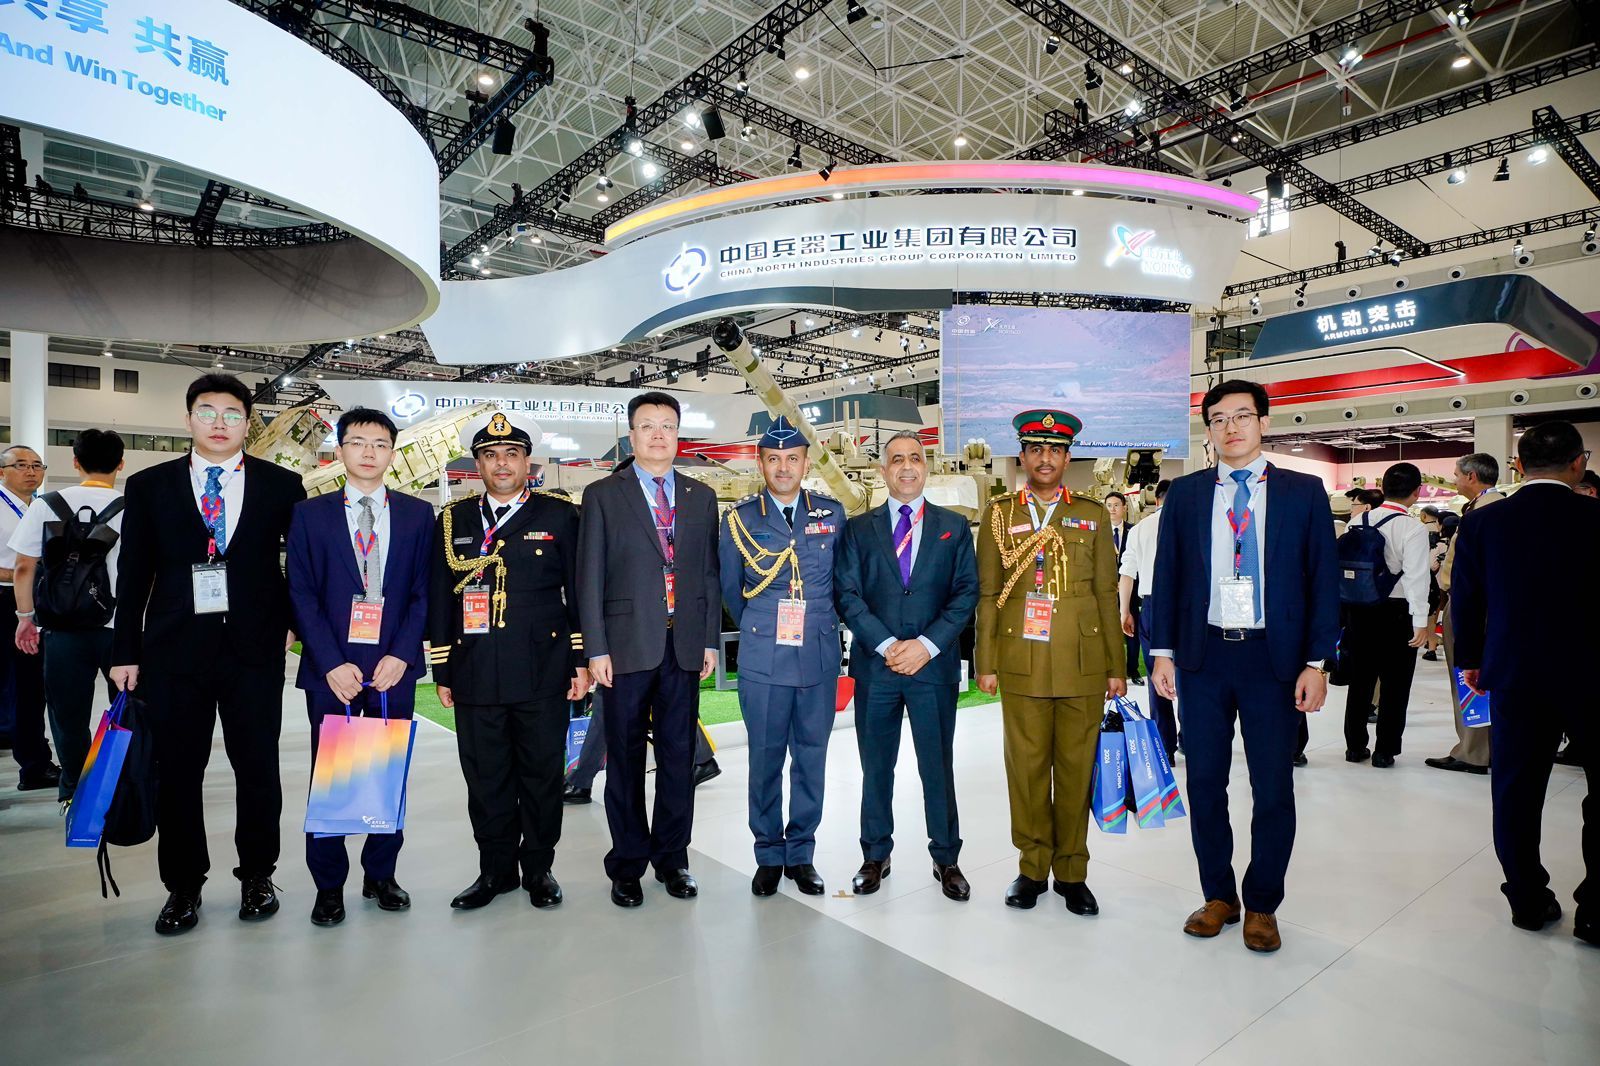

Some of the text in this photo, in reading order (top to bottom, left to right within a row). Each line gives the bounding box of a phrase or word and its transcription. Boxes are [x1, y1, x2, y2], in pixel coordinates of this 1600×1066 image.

[134, 15, 229, 86] 共赢
[0, 32, 227, 122] And Win Together
[719, 226, 1078, 265] 中国兵器工业集团有限公司
[720, 252, 1077, 278] CHINA NORTH INDUSTRIES GROUP CORPORATION LIMITED
[1316, 299, 1417, 333] 机动突击
[1323, 319, 1415, 341] ARMORED ASSAULT
[1091, 440, 1107, 448] Arrow
